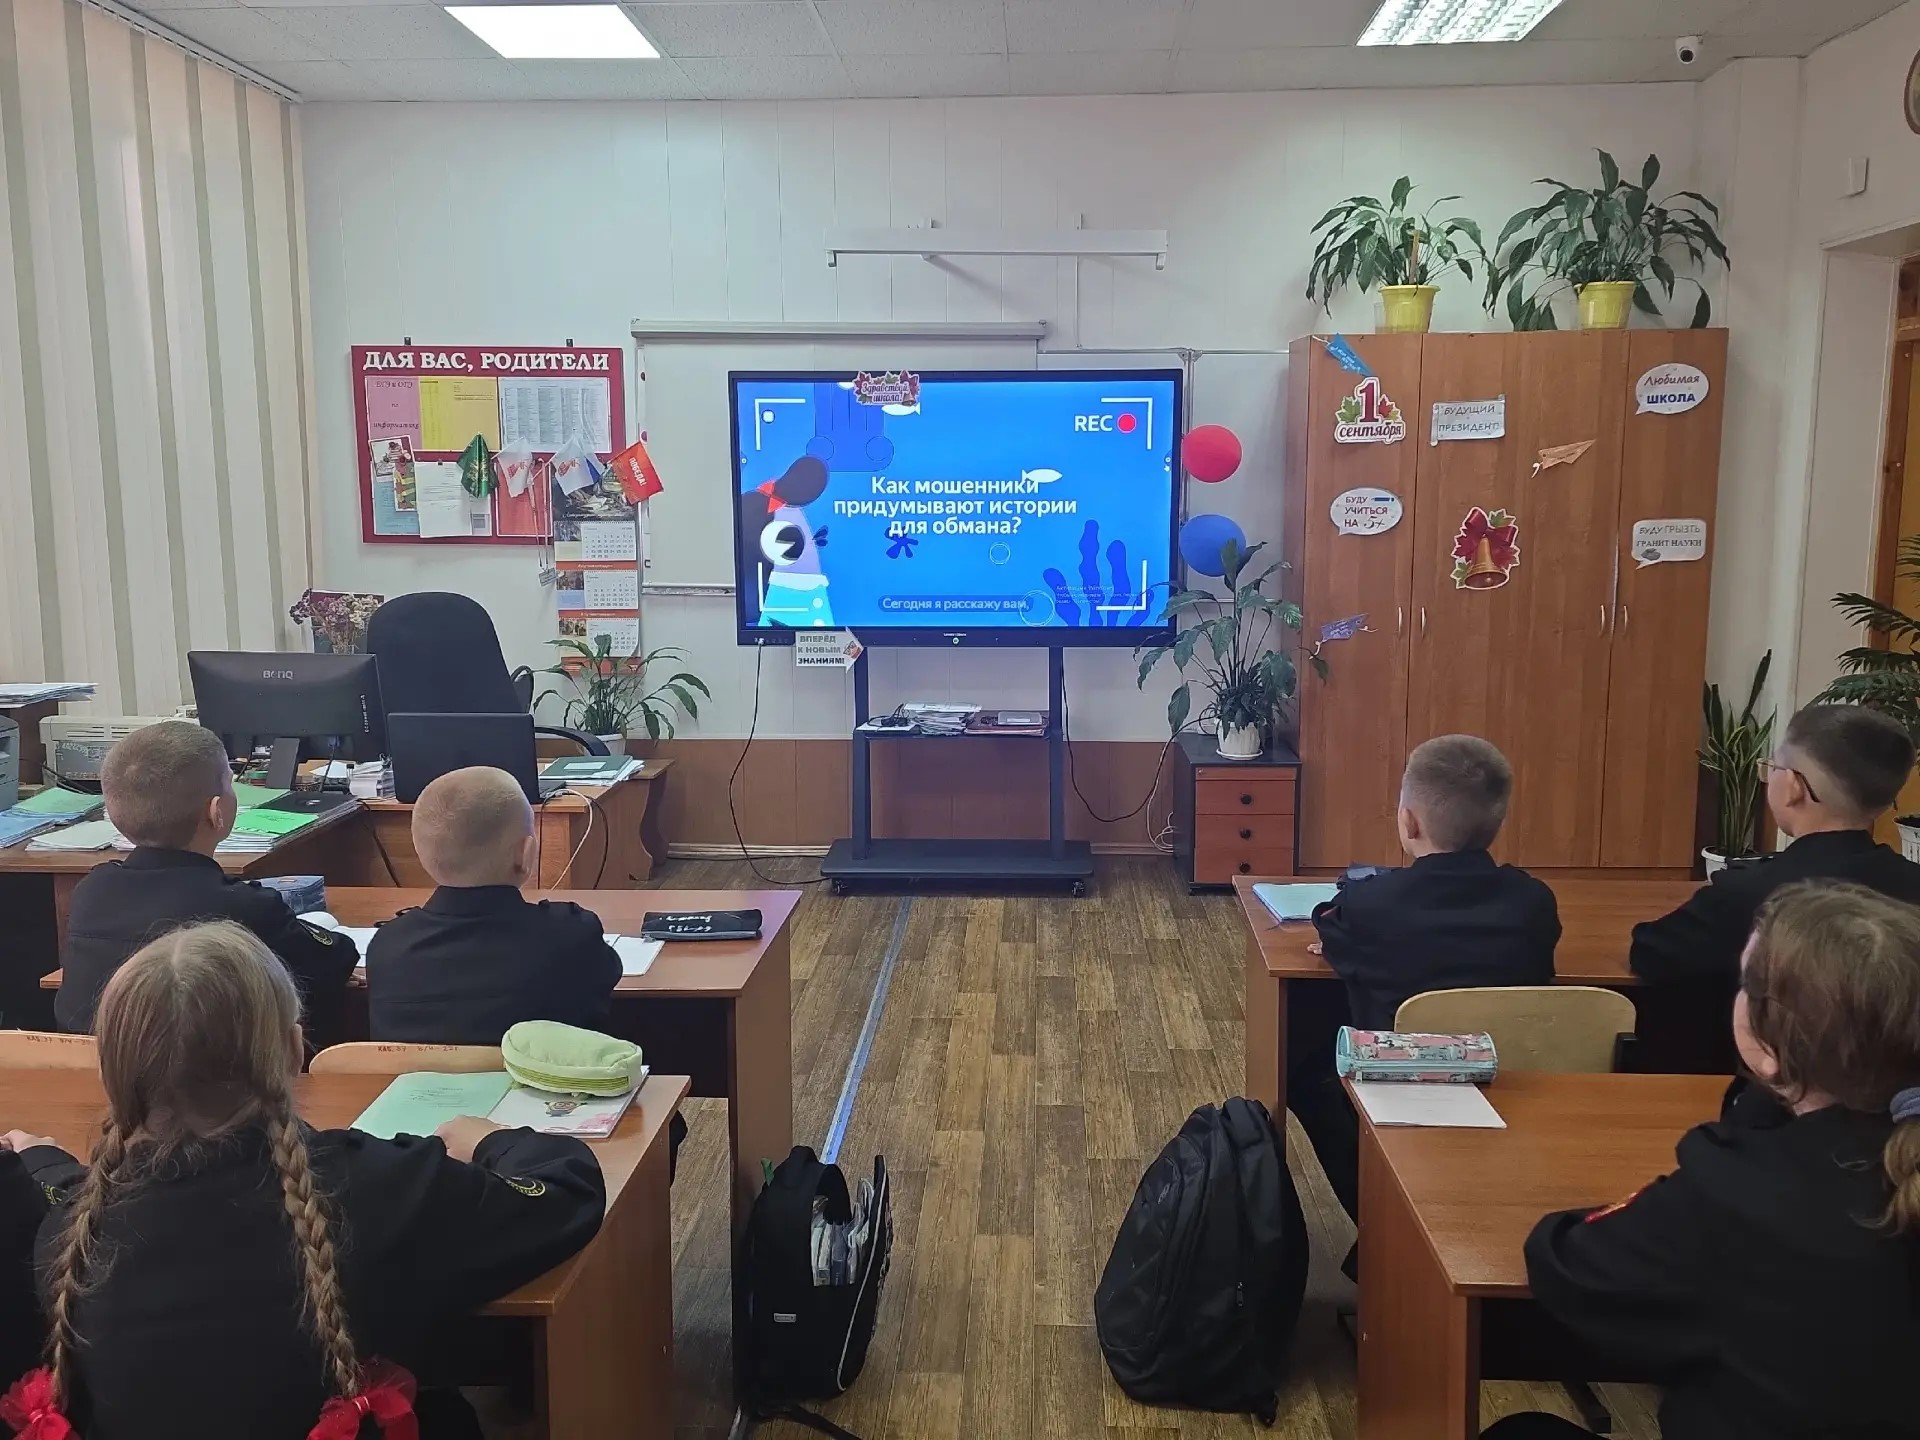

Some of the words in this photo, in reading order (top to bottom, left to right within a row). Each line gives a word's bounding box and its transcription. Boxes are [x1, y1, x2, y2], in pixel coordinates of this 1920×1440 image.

[363, 352, 415, 370] ДЛЯ
[420, 353, 473, 372] ВАС,
[480, 353, 609, 372] РОДИТЕЛИ
[1644, 373, 1700, 386] Любимая
[1359, 382, 1379, 423] 1
[1646, 393, 1696, 405] ШКОЛА
[1444, 404, 1495, 416] БУДУЩИЙ
[1074, 415, 1113, 432] REC
[1339, 422, 1402, 439] сентября
[628, 456, 647, 486] ПОБЕДА!
[871, 477, 910, 494] Как
[914, 478, 1039, 494] мошенники
[1345, 496, 1368, 504] БУДУ
[834, 500, 984, 517] придумывают
[989, 500, 1077, 517] истории
[1345, 506, 1388, 515] УЧИТЬСЯ
[888, 520, 928, 537] для
[932, 517, 1022, 535] обмана?
[1345, 518, 1358, 527] НА
[1640, 526, 1663, 535] БУДУ
[1665, 524, 1700, 533] ГРЫЗТЬ
[882, 598, 932, 611] Сегодня
[934, 600, 942, 609] я
[944, 600, 1001, 611] расскажу
[800, 634, 836, 643] ВПЕРЁД
[797, 657, 845, 665] ЗНАНИЯМ!
[263, 670, 293, 680] BenQ
